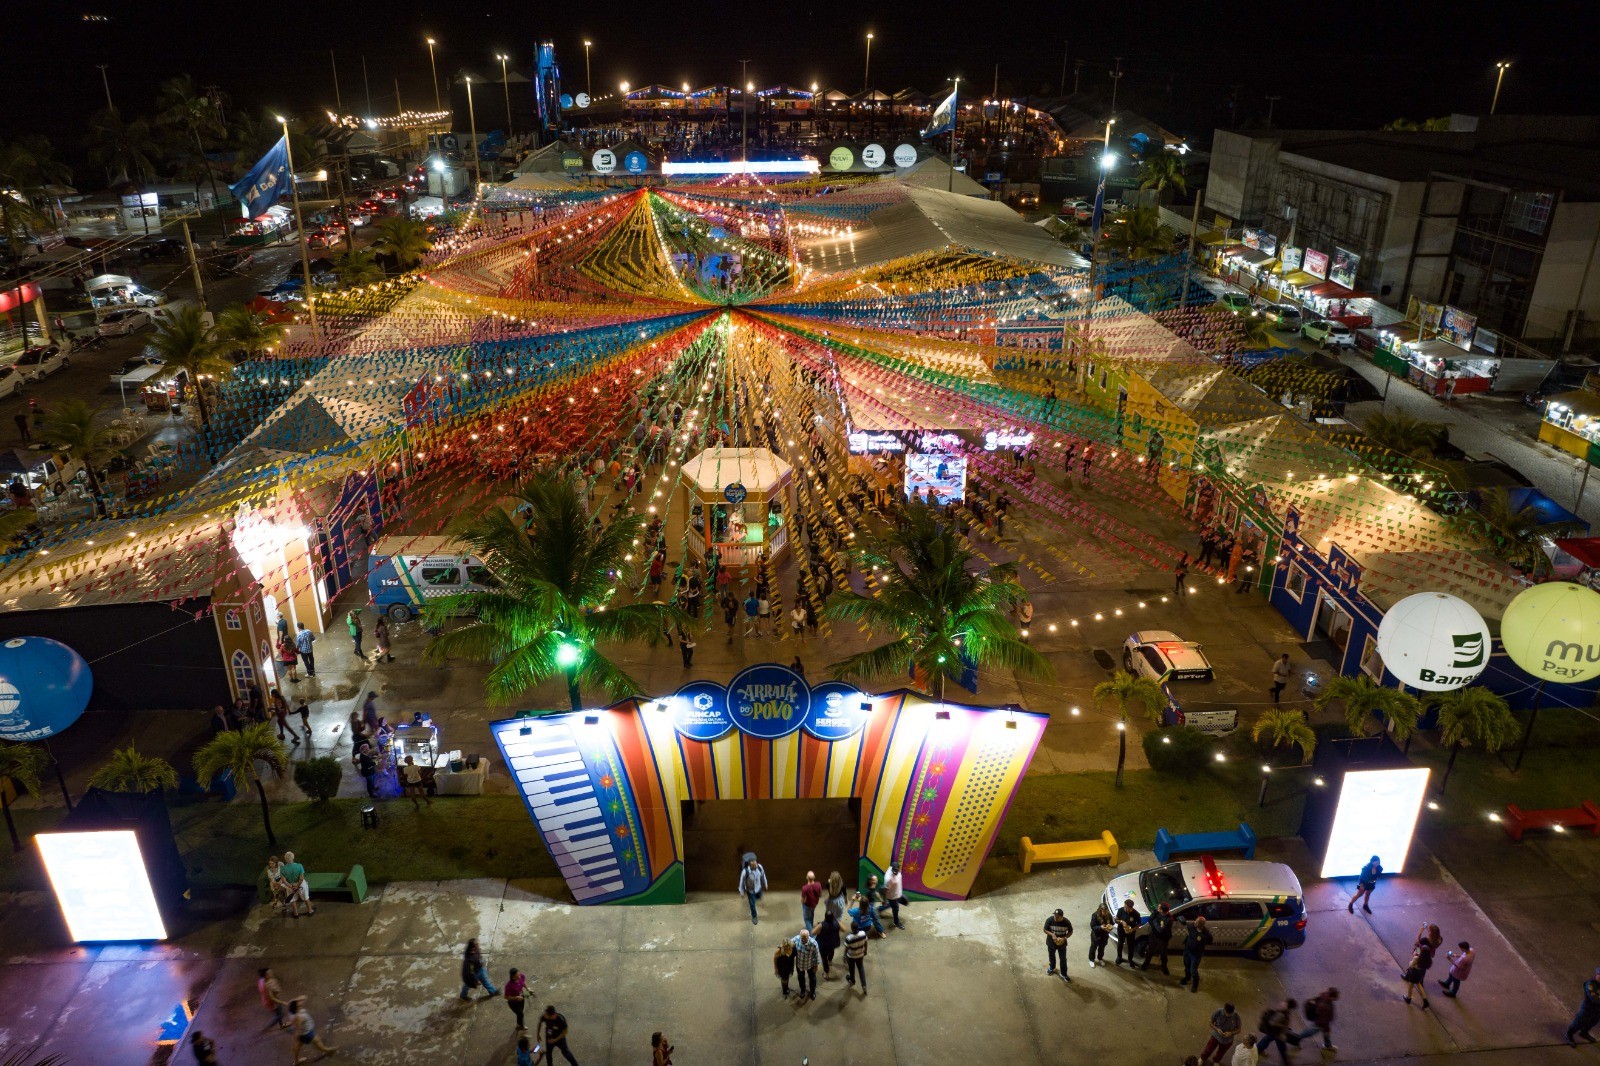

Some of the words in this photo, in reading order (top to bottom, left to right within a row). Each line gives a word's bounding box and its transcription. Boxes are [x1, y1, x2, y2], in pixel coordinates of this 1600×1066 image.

[381, 578, 398, 586] 190
[1541, 659, 1585, 678] Pay
[738, 681, 798, 702] ARRAIÁ
[740, 706, 753, 716] DO
[752, 700, 793, 721] POVO
